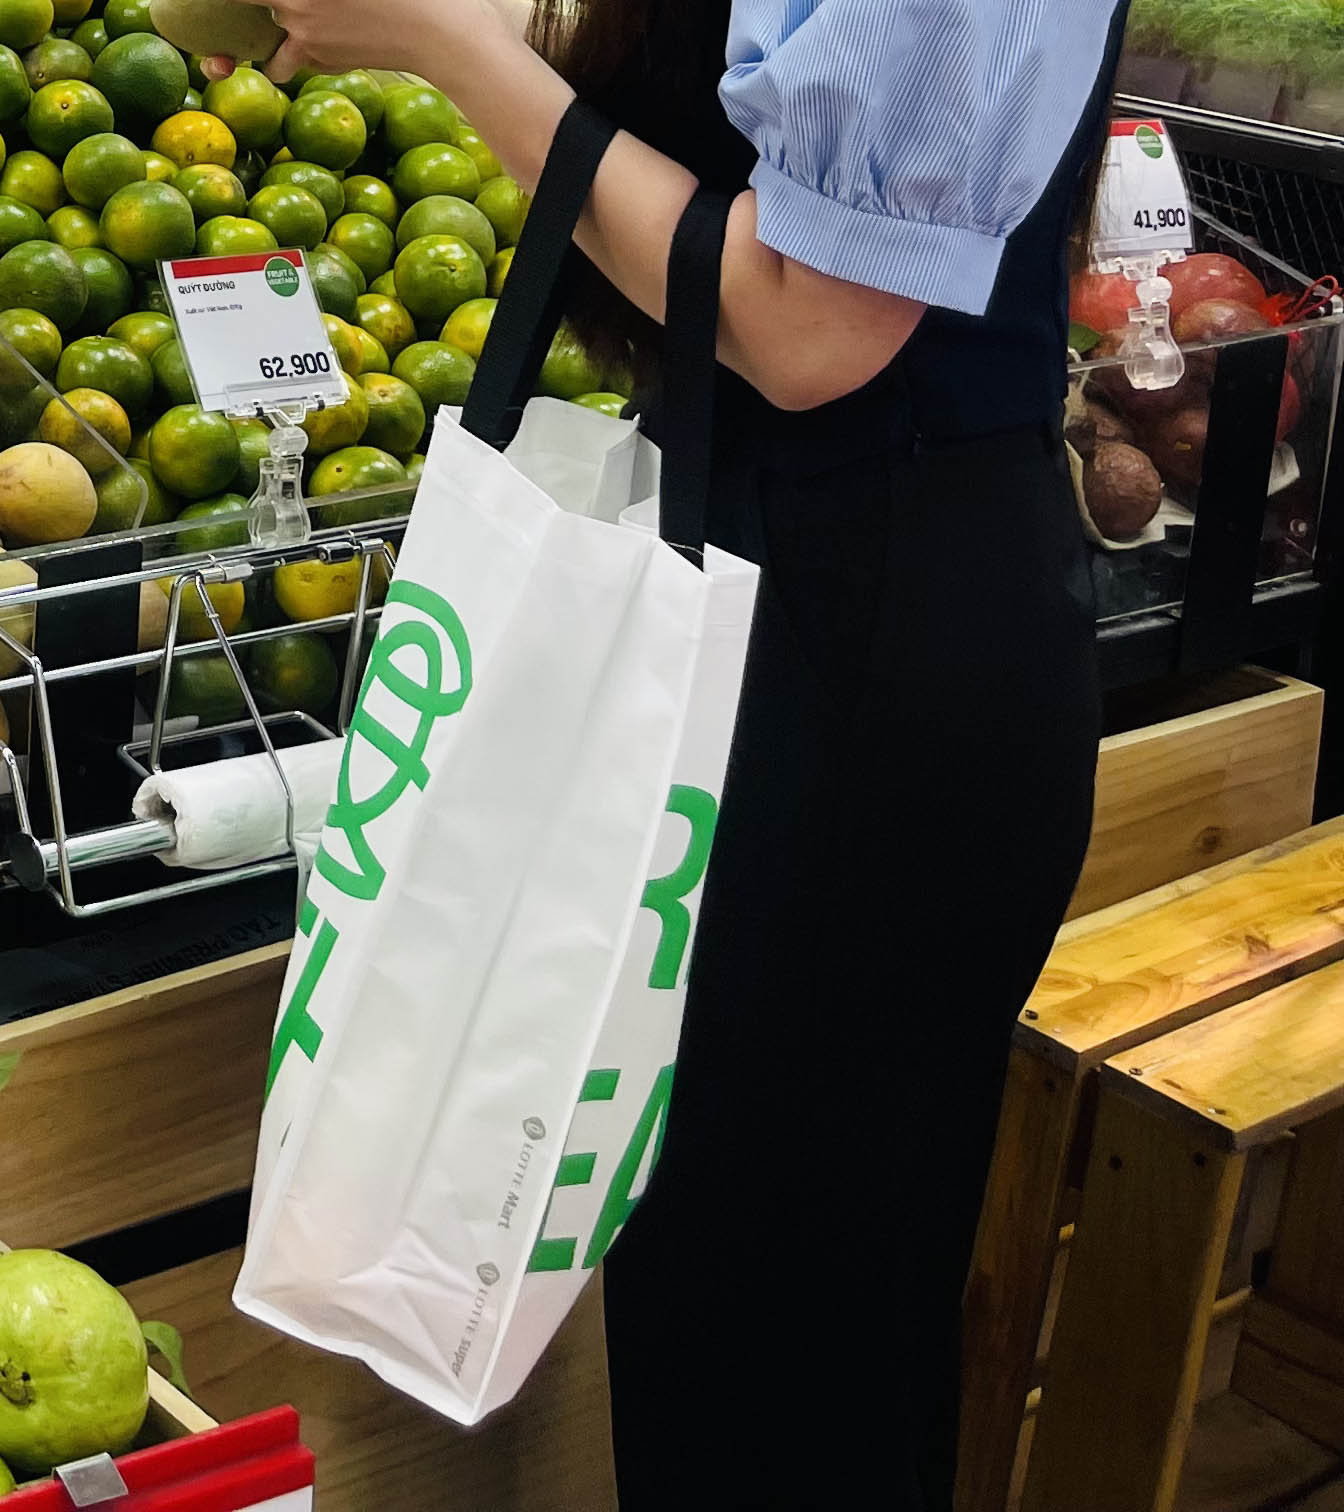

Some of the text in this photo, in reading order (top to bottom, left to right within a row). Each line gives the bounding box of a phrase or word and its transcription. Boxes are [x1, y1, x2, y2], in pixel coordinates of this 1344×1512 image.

[1133, 208, 1185, 230] 41,900
[259, 351, 330, 379] 62,900
[498, 1142, 534, 1229] LOTTE Mart
[451, 1339, 472, 1378] super
